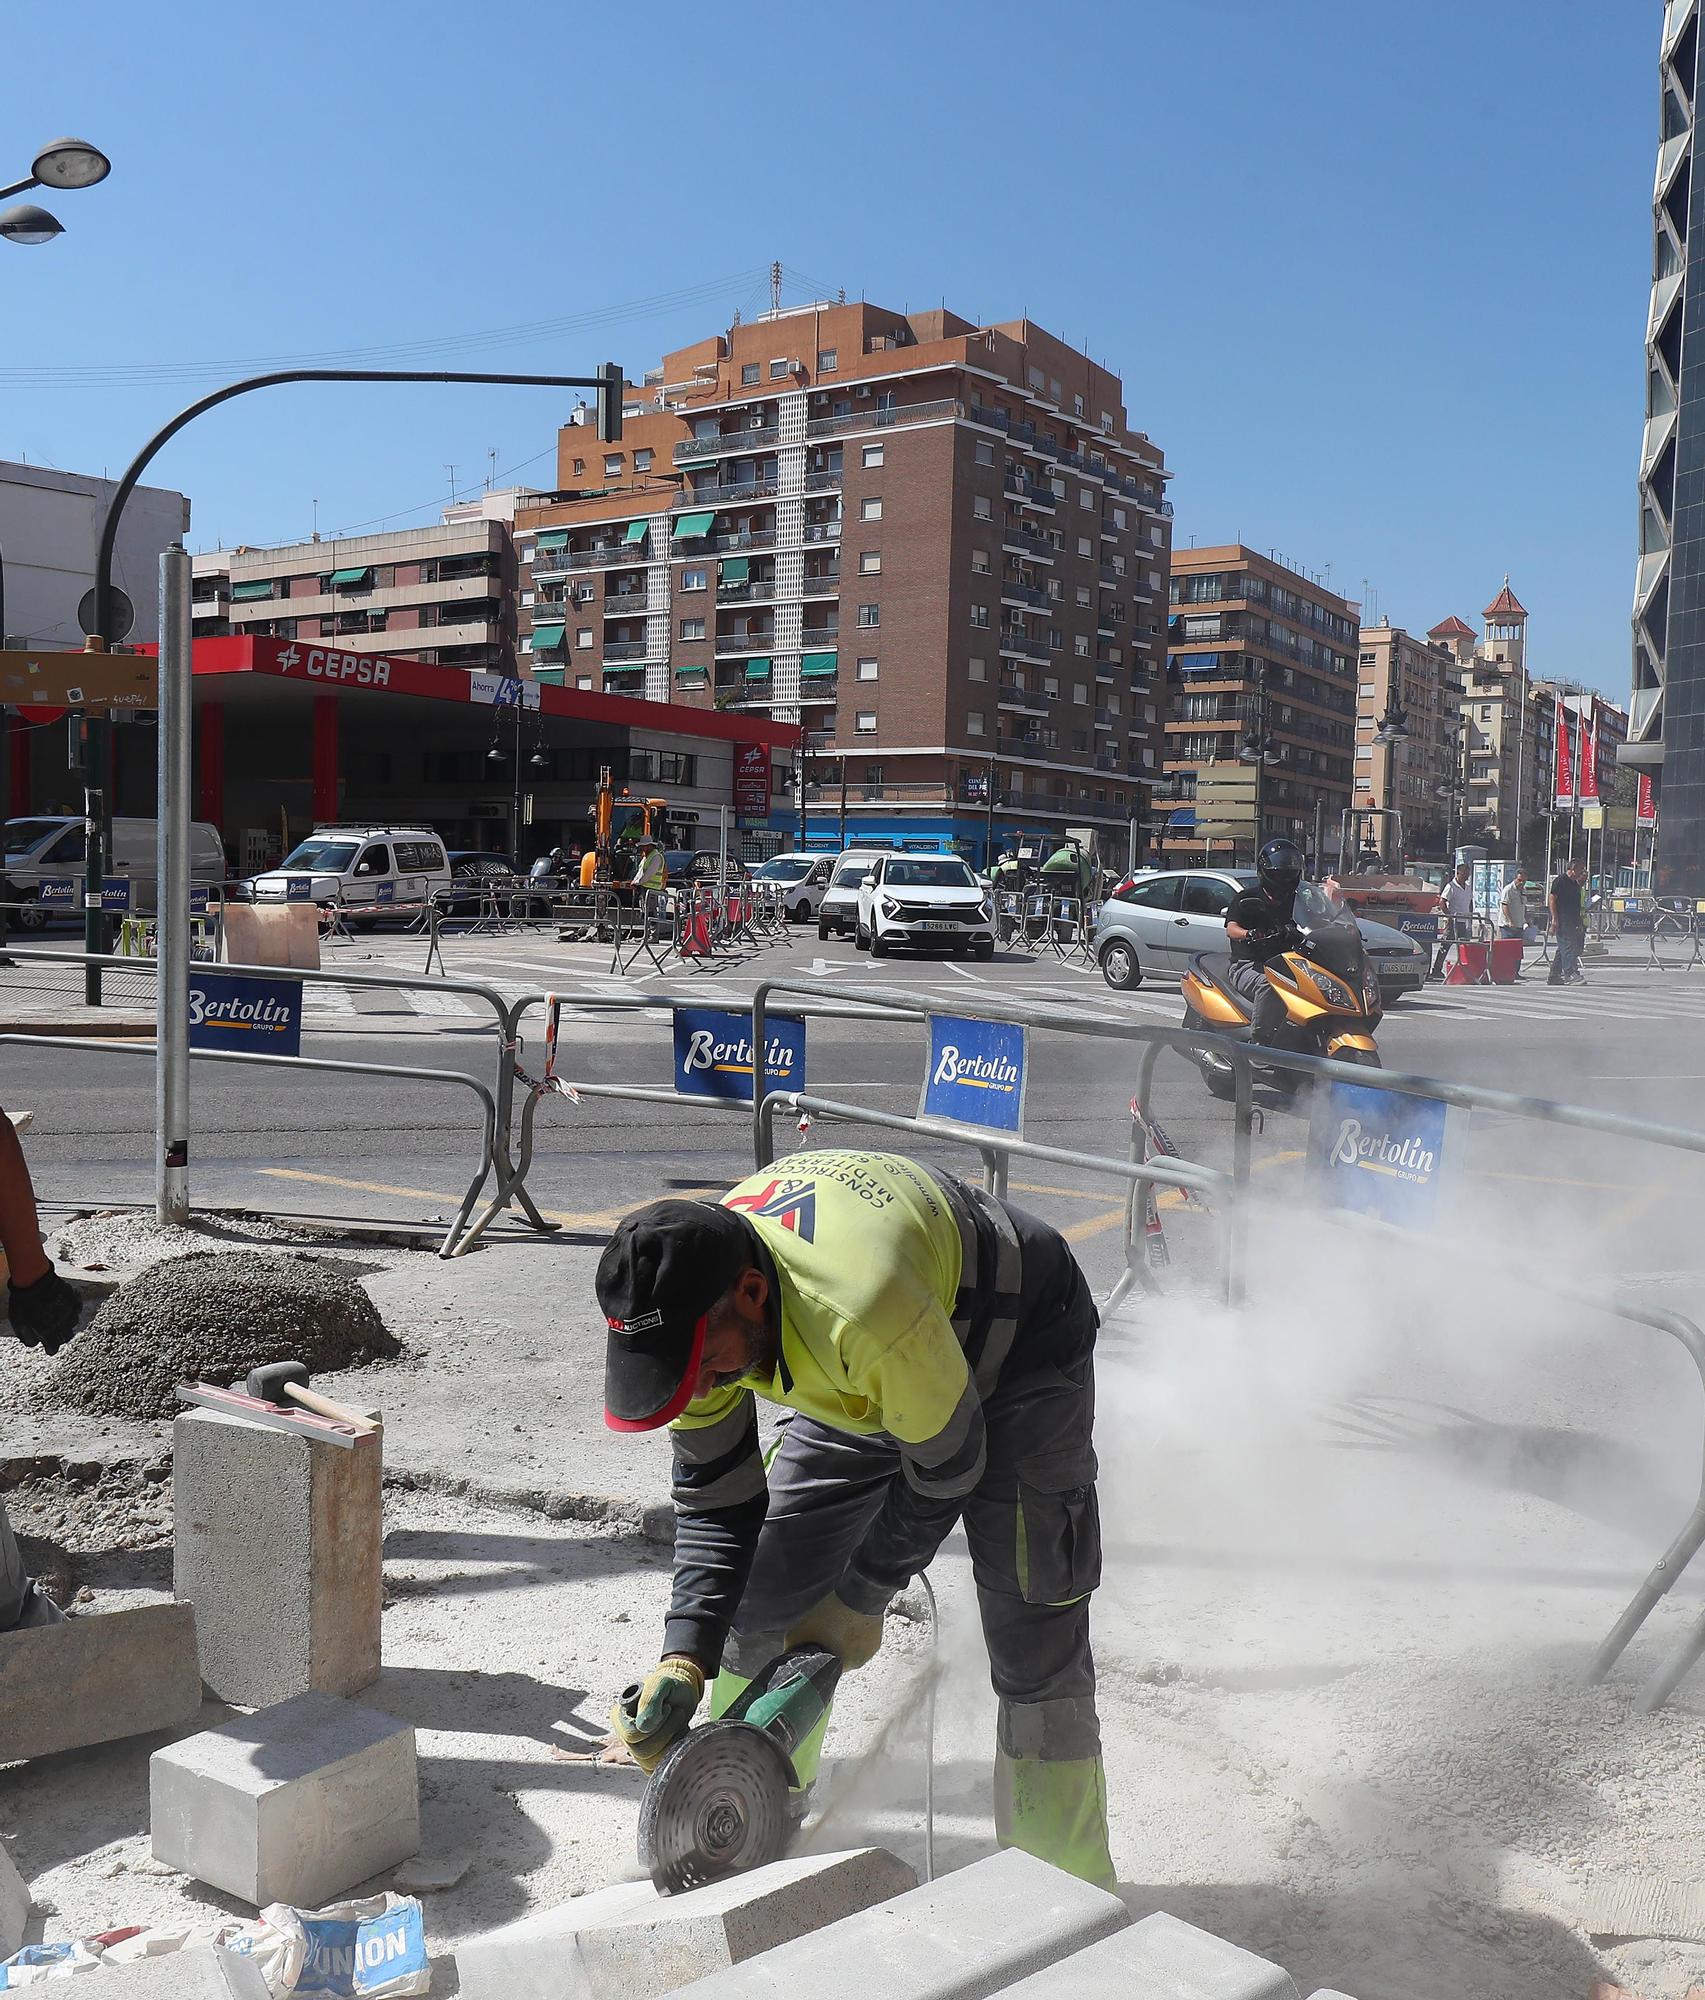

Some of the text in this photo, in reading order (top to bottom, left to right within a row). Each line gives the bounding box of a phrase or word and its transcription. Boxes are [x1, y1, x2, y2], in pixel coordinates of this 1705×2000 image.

[307, 649, 391, 686] CEPSA
[471, 680, 495, 693] Ahorra
[42, 884, 74, 898] Bertolín
[101, 888, 128, 898] rtolín
[945, 922, 957, 930] LVC
[1400, 920, 1435, 933] Bertolín
[189, 990, 290, 1025] Bertolín
[252, 1023, 274, 1031] GRUPO
[683, 1030, 794, 1075] Bertoín
[933, 1045, 1018, 1086] Bertolín
[988, 1082, 1005, 1091] GRUPO
[1330, 1119, 1434, 1172] Bertolín
[1397, 1170, 1417, 1183] GRUPO
